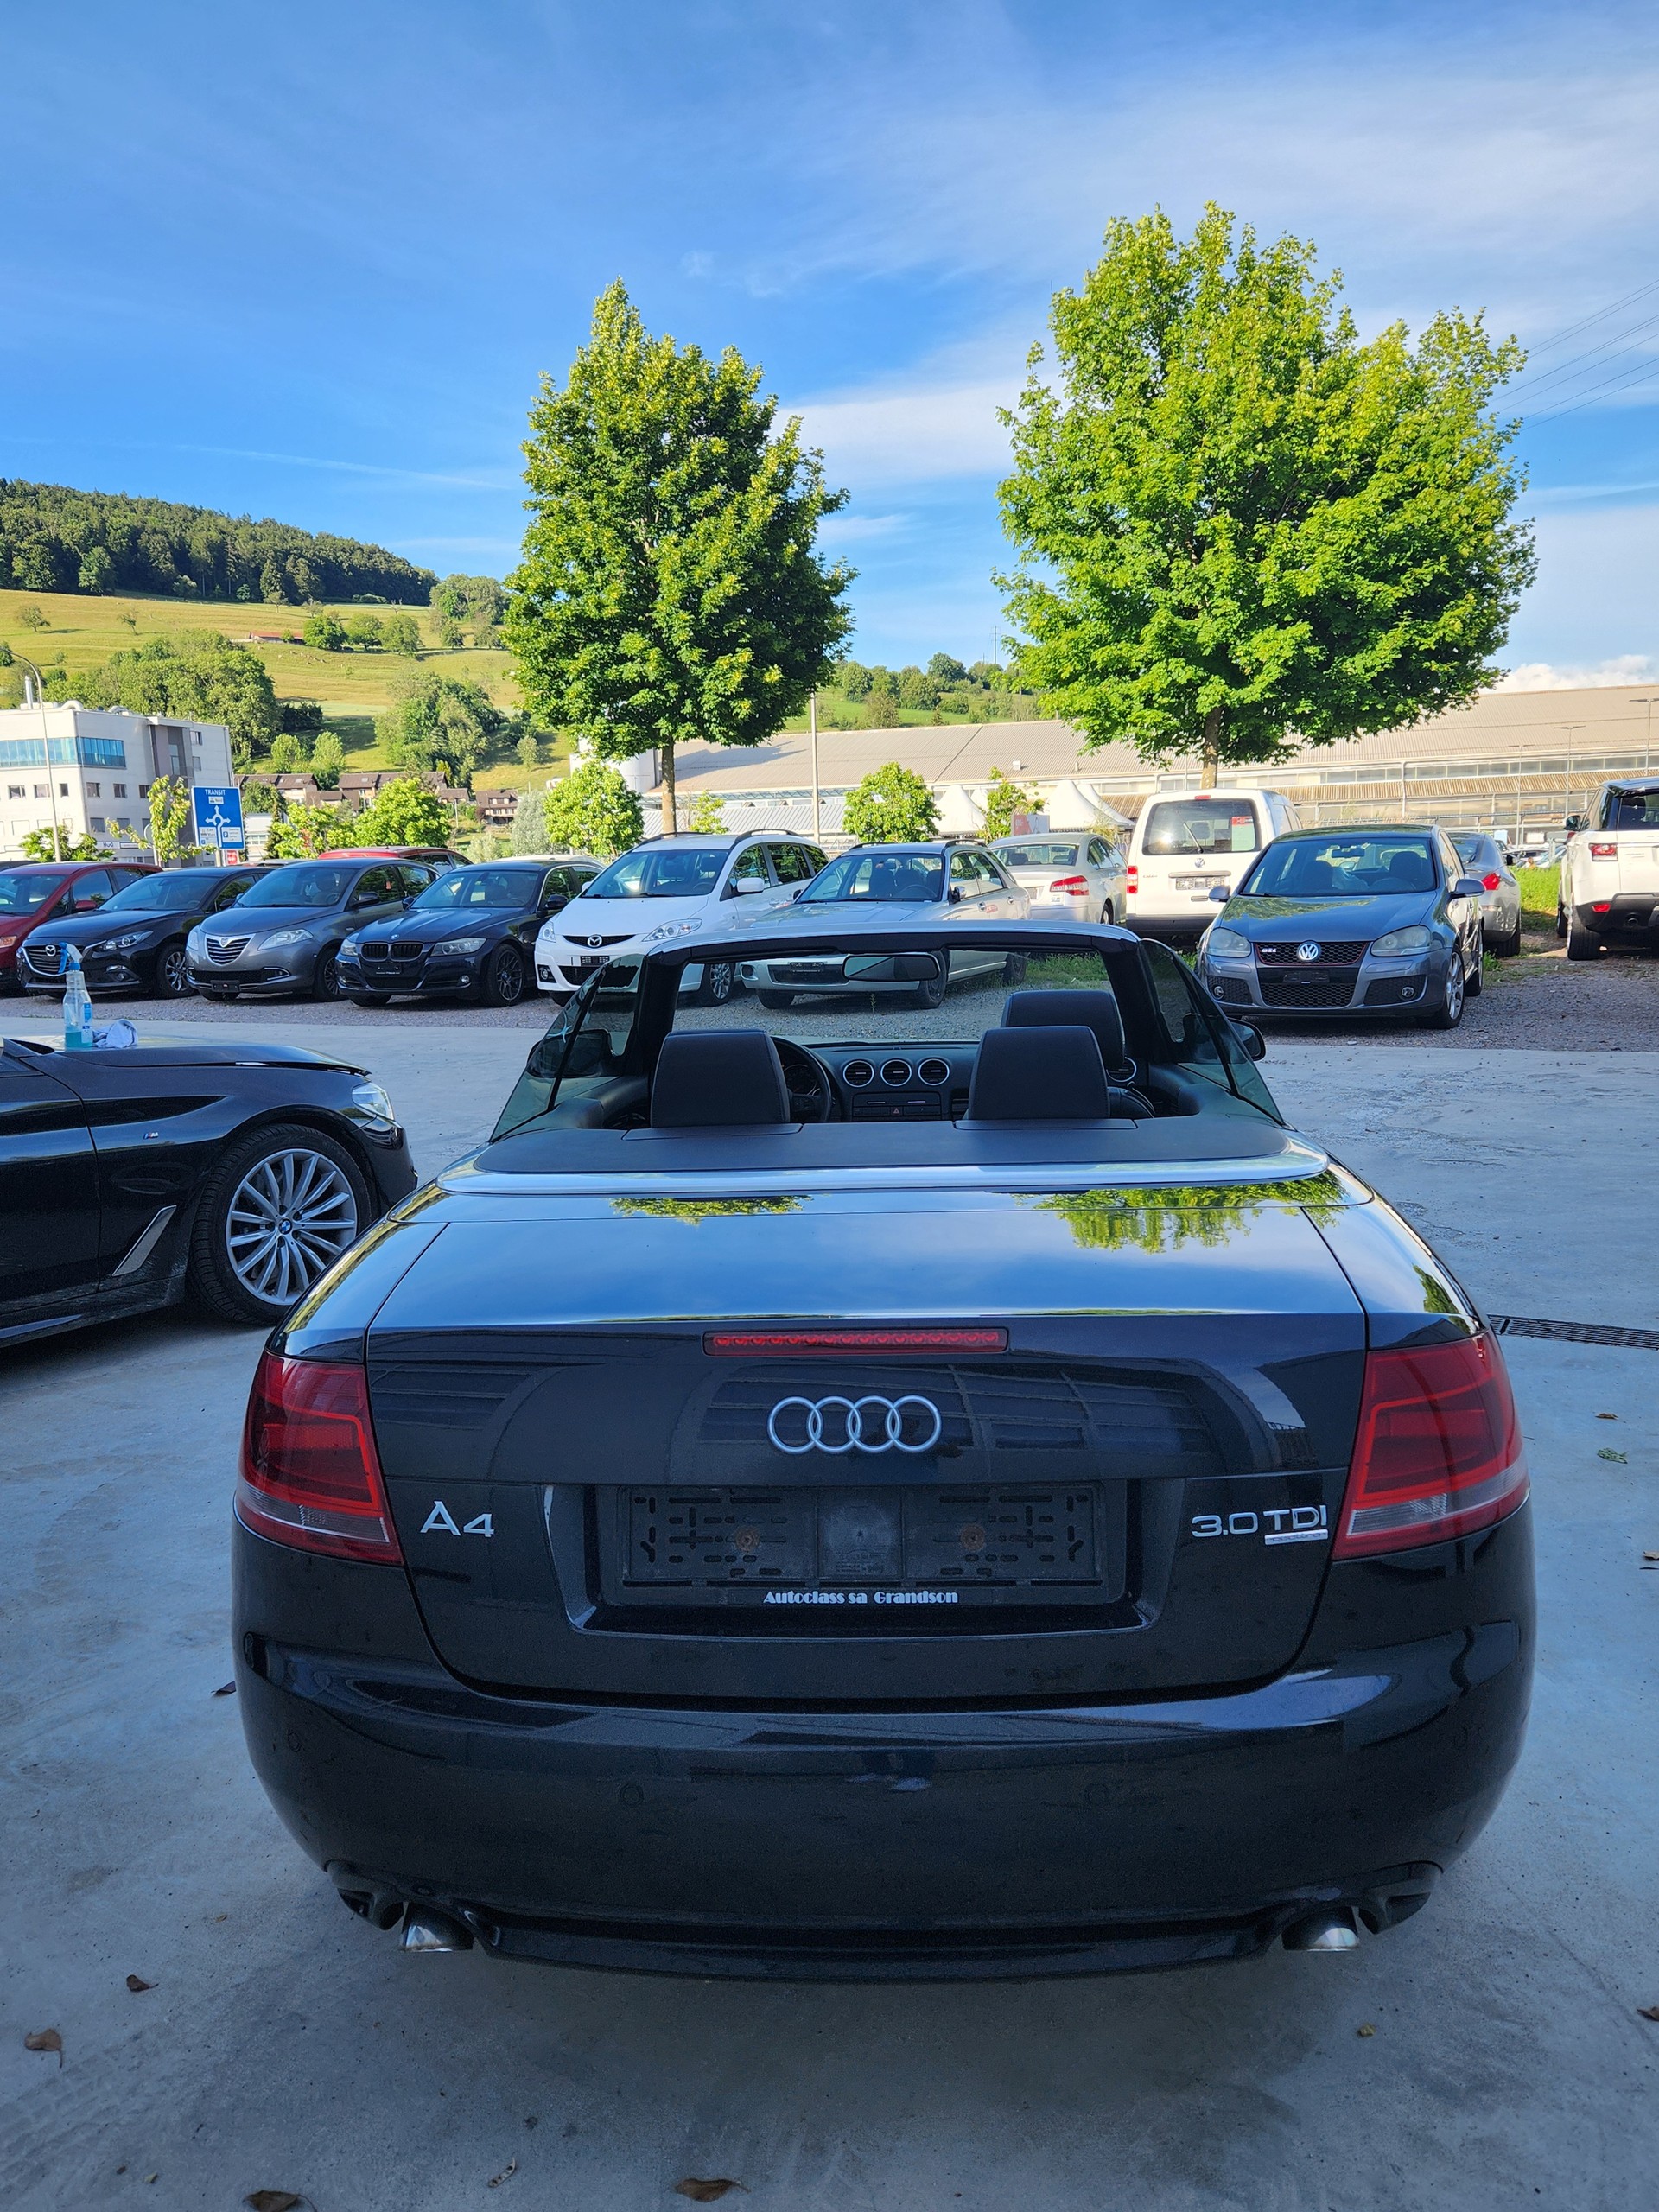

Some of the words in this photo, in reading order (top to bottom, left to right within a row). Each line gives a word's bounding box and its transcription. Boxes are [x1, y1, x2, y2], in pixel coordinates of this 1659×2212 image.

[1299, 942, 1319, 960] VW
[420, 1500, 494, 1538] A4
[1192, 1512, 1258, 1537] 3.0
[1263, 1505, 1327, 1531] TDI
[763, 1591, 845, 1604] Autoclass
[848, 1592, 868, 1604] sa
[874, 1590, 958, 1604] Grandson
